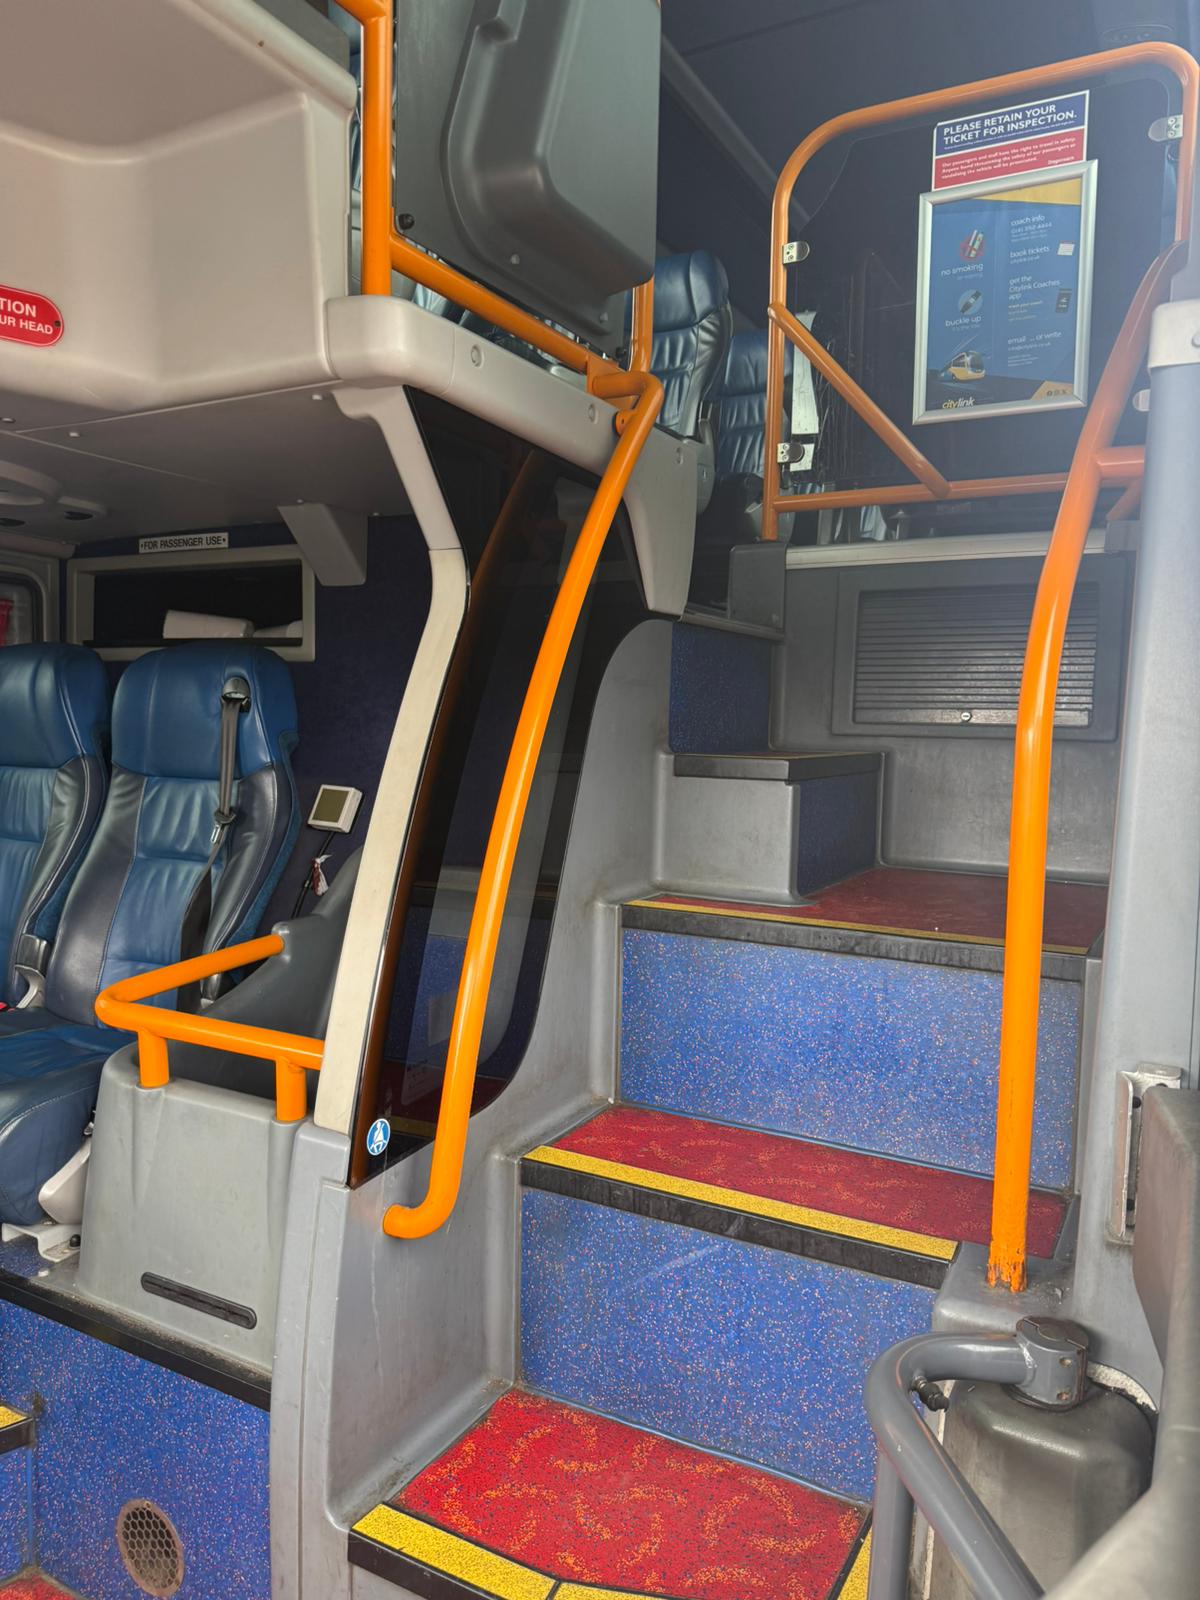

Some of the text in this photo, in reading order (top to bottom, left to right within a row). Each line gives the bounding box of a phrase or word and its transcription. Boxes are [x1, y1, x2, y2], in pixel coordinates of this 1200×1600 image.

[943, 120, 982, 137] PLEASE
[983, 111, 1023, 128] RETAIN
[1025, 104, 1057, 118] YOUR
[943, 130, 983, 145] TICKET
[983, 125, 1005, 137] FOR
[1007, 110, 1077, 132] INSPECTION.
[1010, 213, 1046, 226] coach info
[1010, 245, 1050, 258] book tickets
[940, 269, 951, 277] no
[951, 263, 984, 274] smoking
[1009, 275, 1032, 287] get the
[1009, 279, 1061, 294] Citylink Coaches
[20, 318, 54, 335] HEAD
[945, 315, 982, 327] buckle up
[1008, 335, 1026, 345] email
[1042, 330, 1062, 339] write
[942, 396, 975, 410] citylink
[143, 535, 223, 551] FOR PASSENGER USE
